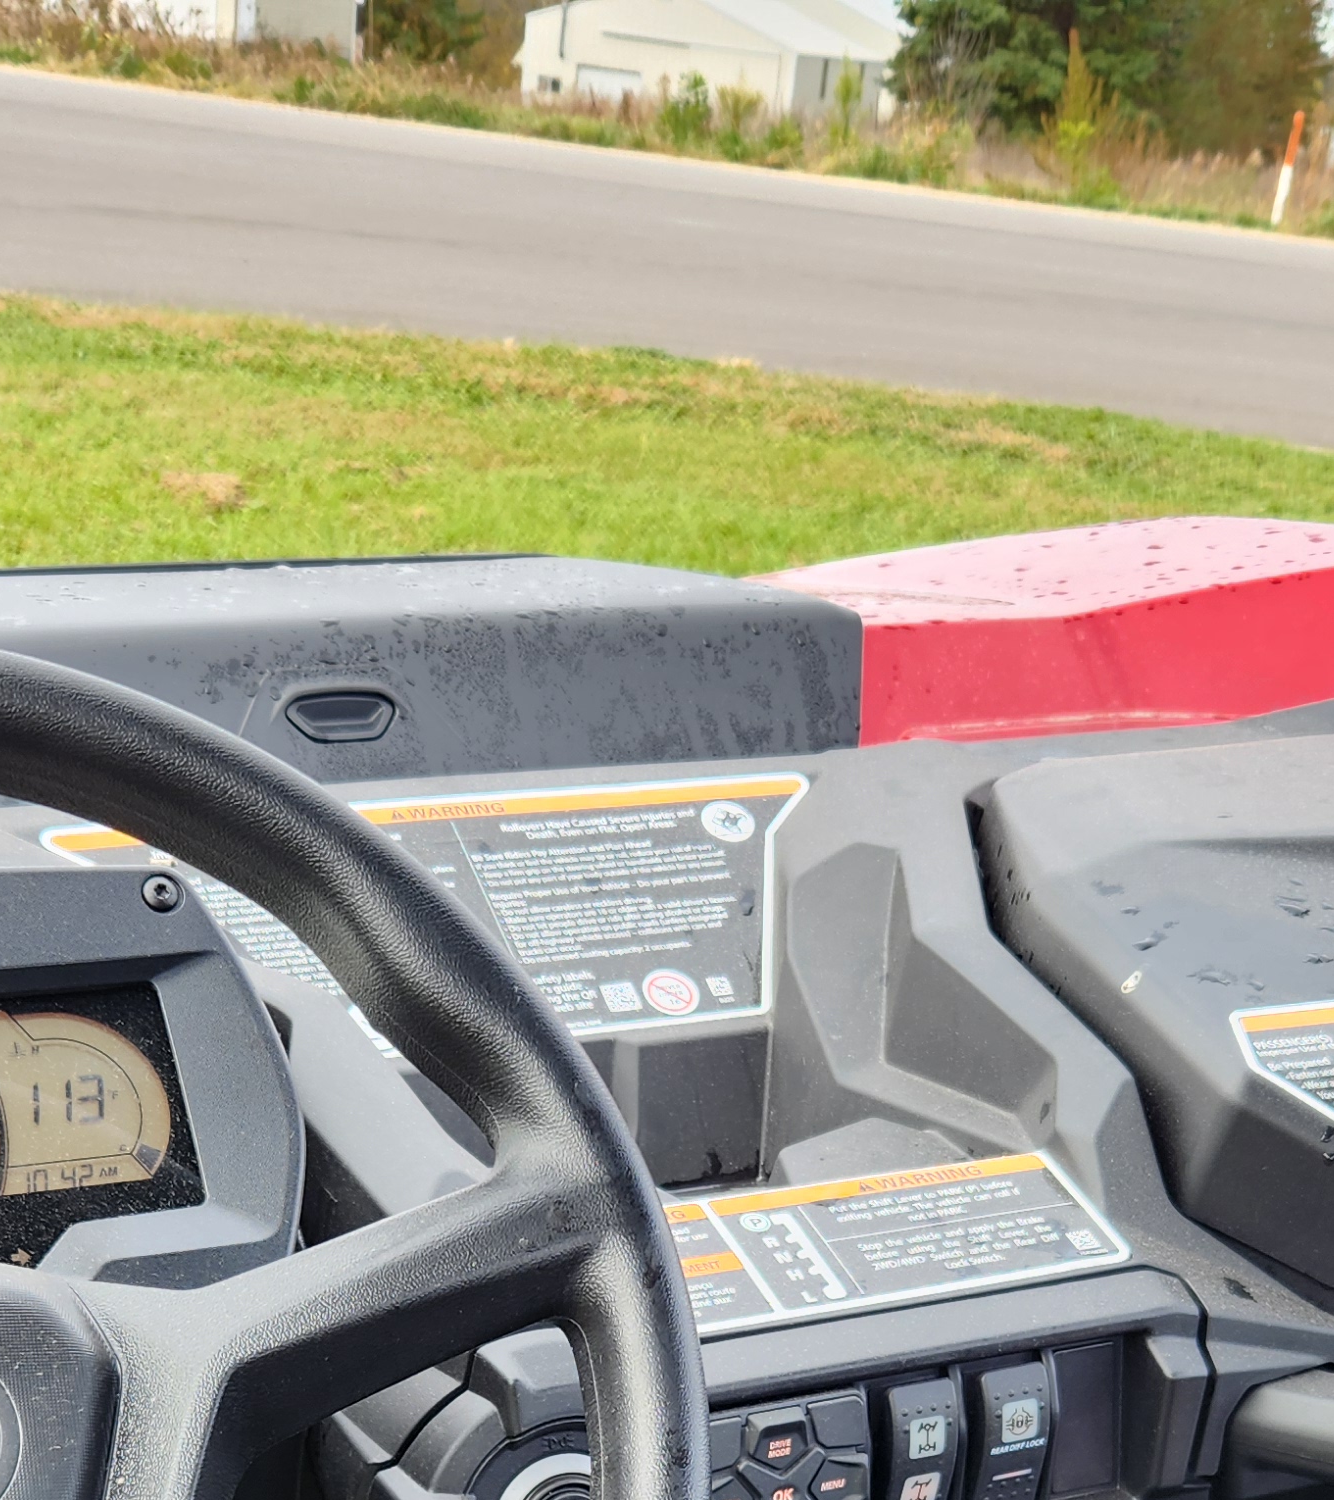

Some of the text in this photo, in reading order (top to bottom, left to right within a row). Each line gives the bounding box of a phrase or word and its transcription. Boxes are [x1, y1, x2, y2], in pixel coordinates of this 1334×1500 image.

[407, 802, 505, 820] WARNING
[499, 809, 694, 833] Rollovers Have Caused Severe Injuries and
[526, 830, 559, 840] Death,
[560, 828, 583, 837] Even
[600, 824, 621, 834] Flat,
[621, 822, 647, 833] Open
[649, 819, 677, 829] Areas.
[1253, 1035, 1332, 1050] PASSENGER(S)
[33, 1074, 105, 1125] 113
[99, 1167, 118, 1177] AM
[876, 1165, 982, 1189] WARNING
[828, 1206, 847, 1214] Put
[849, 1202, 867, 1211] the
[869, 1198, 892, 1208] Shift
[893, 1194, 922, 1204] Lever
[937, 1187, 965, 1196] PARK
[965, 1185, 981, 1193] (P)
[980, 1181, 1013, 1190] before
[837, 1212, 872, 1223] exiting
[874, 1206, 913, 1217] vehicle.
[912, 1202, 934, 1210] The
[936, 1196, 971, 1207] vehicle
[993, 1189, 1011, 1198] roll
[1011, 1187, 1021, 1195] if
[908, 1214, 926, 1222] not
[937, 1206, 967, 1216] PARK.
[751, 1218, 762, 1228] P
[857, 1216, 1045, 1251] Stop the vehicle and apply the Brake
[762, 1237, 780, 1248] R
[864, 1225, 1052, 1261] before using the Shift Lever, the
[773, 1251, 793, 1264] N
[872, 1232, 1059, 1271] 2WD/4WD Switch and the Rear Diff
[944, 1254, 1005, 1269] Lock Switch.
[786, 1269, 805, 1281] H
[800, 1291, 818, 1303] L
[768, 1447, 791, 1458] MODE
[769, 1439, 791, 1450] DRIVE
[990, 1438, 1045, 1455] REAR DIFF LOCK
[820, 1478, 845, 1491] MENU
